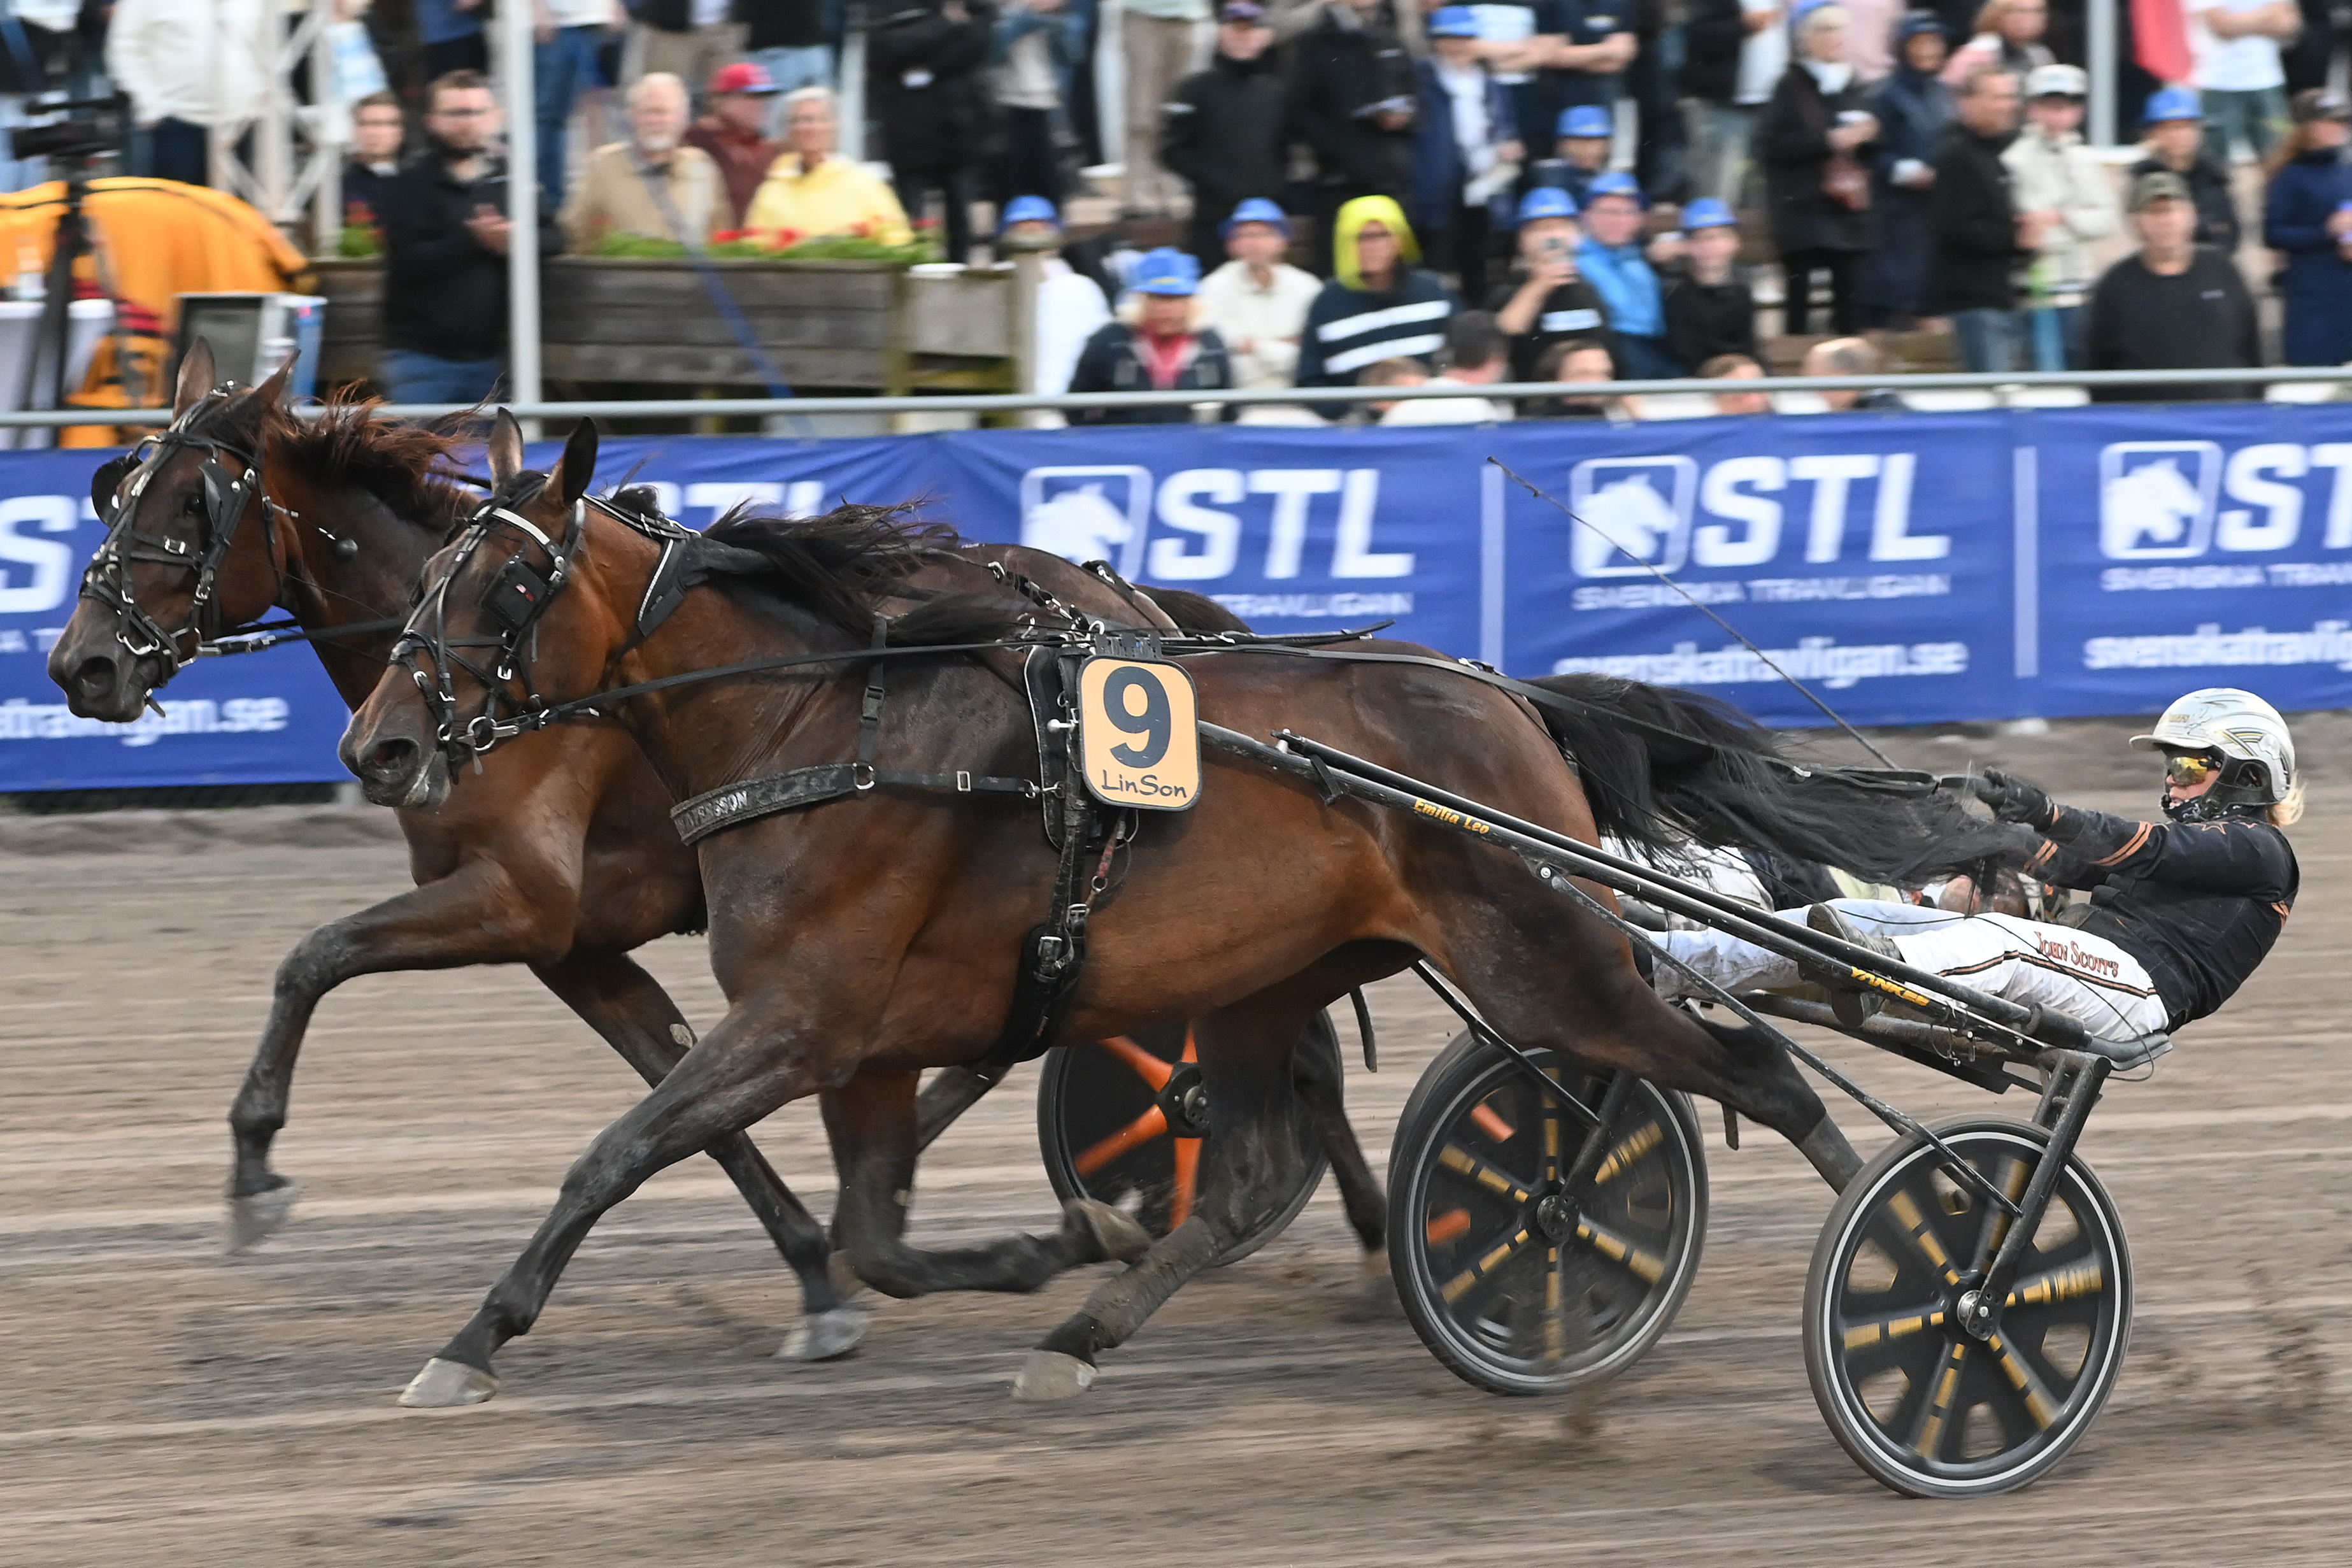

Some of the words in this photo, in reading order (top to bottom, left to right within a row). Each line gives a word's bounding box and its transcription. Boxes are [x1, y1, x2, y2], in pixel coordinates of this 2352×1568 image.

[1148, 467, 1416, 580] STL
[1692, 453, 1952, 567] STL
[1104, 666, 1171, 769] 9
[1102, 769, 1187, 798] LinSon
[1463, 815, 1490, 834] Leo
